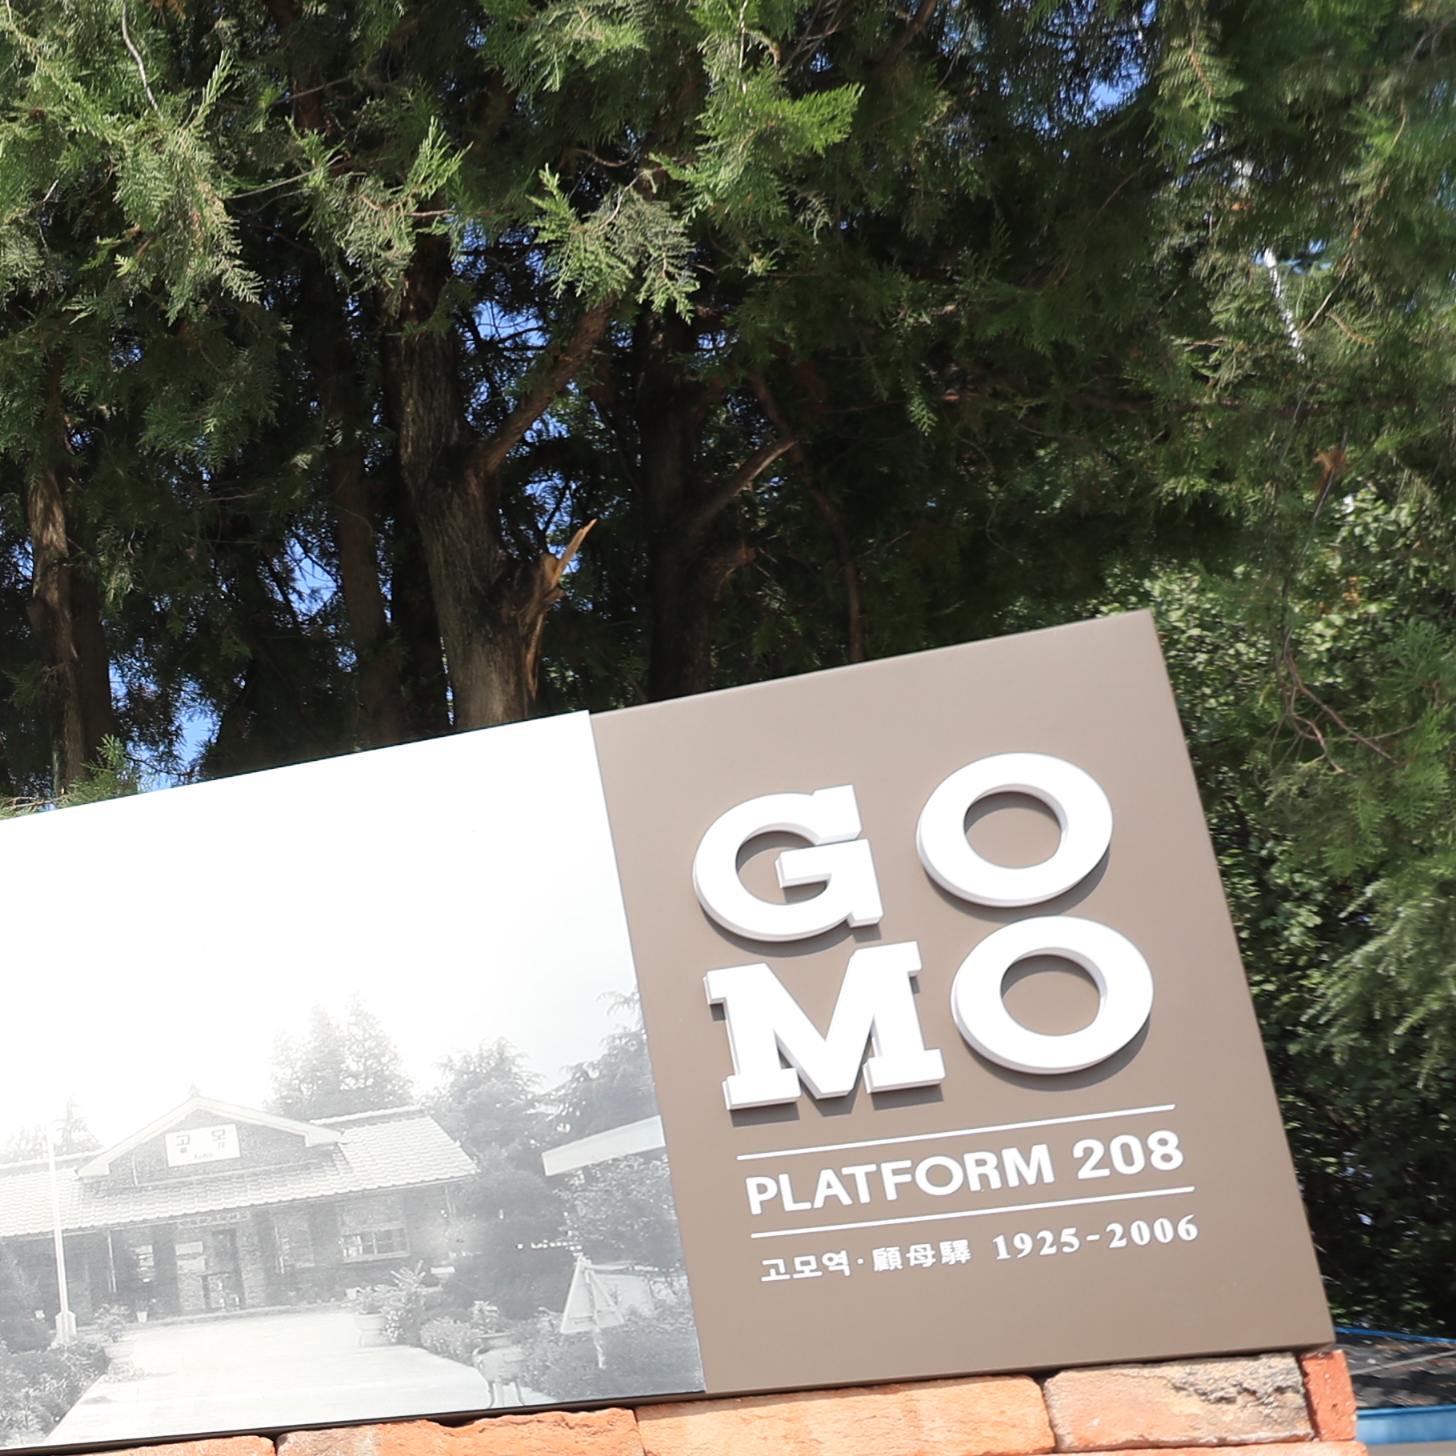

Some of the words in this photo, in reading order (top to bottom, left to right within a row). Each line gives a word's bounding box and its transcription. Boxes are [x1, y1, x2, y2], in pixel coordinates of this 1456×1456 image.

[692, 752, 1114, 942] GO
[703, 915, 1154, 1110] MO
[744, 1143, 1056, 1217] PLATFORM
[1072, 1130, 1184, 1180] 208
[992, 1214, 1198, 1260] 1925-2006
